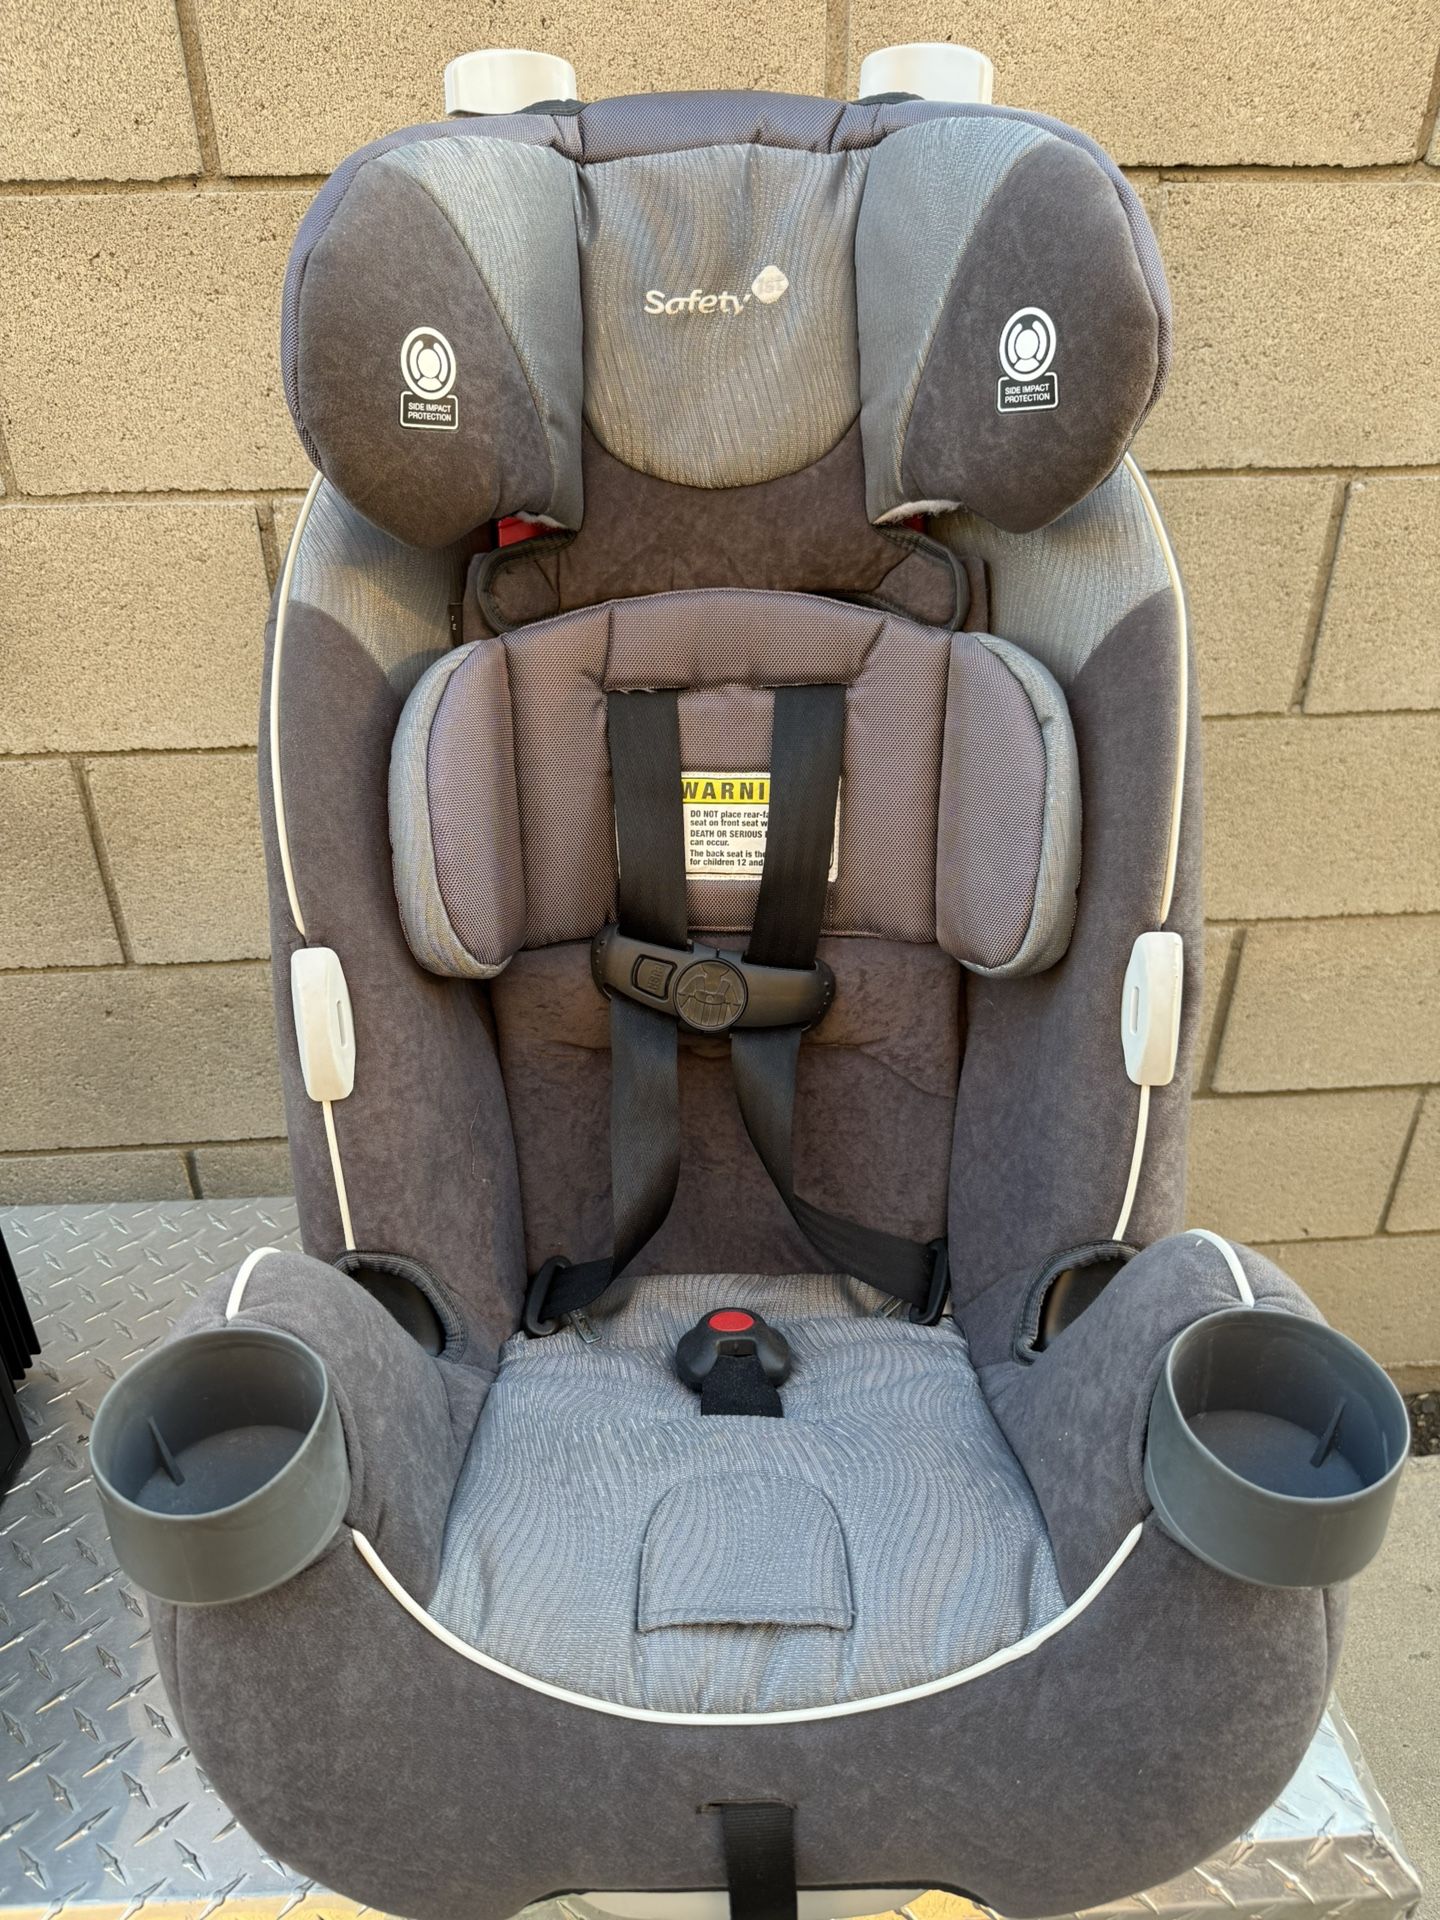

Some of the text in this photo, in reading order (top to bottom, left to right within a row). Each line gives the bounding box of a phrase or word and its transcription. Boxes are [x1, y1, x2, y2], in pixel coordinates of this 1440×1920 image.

[643, 289, 744, 315] Safety
[1004, 383, 1050, 395] SIDE IMPACT
[1004, 392, 1050, 404] PROTECTION
[408, 402, 452, 413] SIDE IMPACT
[407, 411, 452, 422] PROTECTION
[690, 810, 701, 818] DO
[703, 810, 719, 818] NOT
[720, 811, 742, 819] place
[741, 819, 759, 827] seat
[690, 830, 715, 838] DEATH
[716, 830, 727, 838] OR
[690, 849, 704, 857] The
[689, 858, 701, 866] for
[703, 858, 735, 866] children
